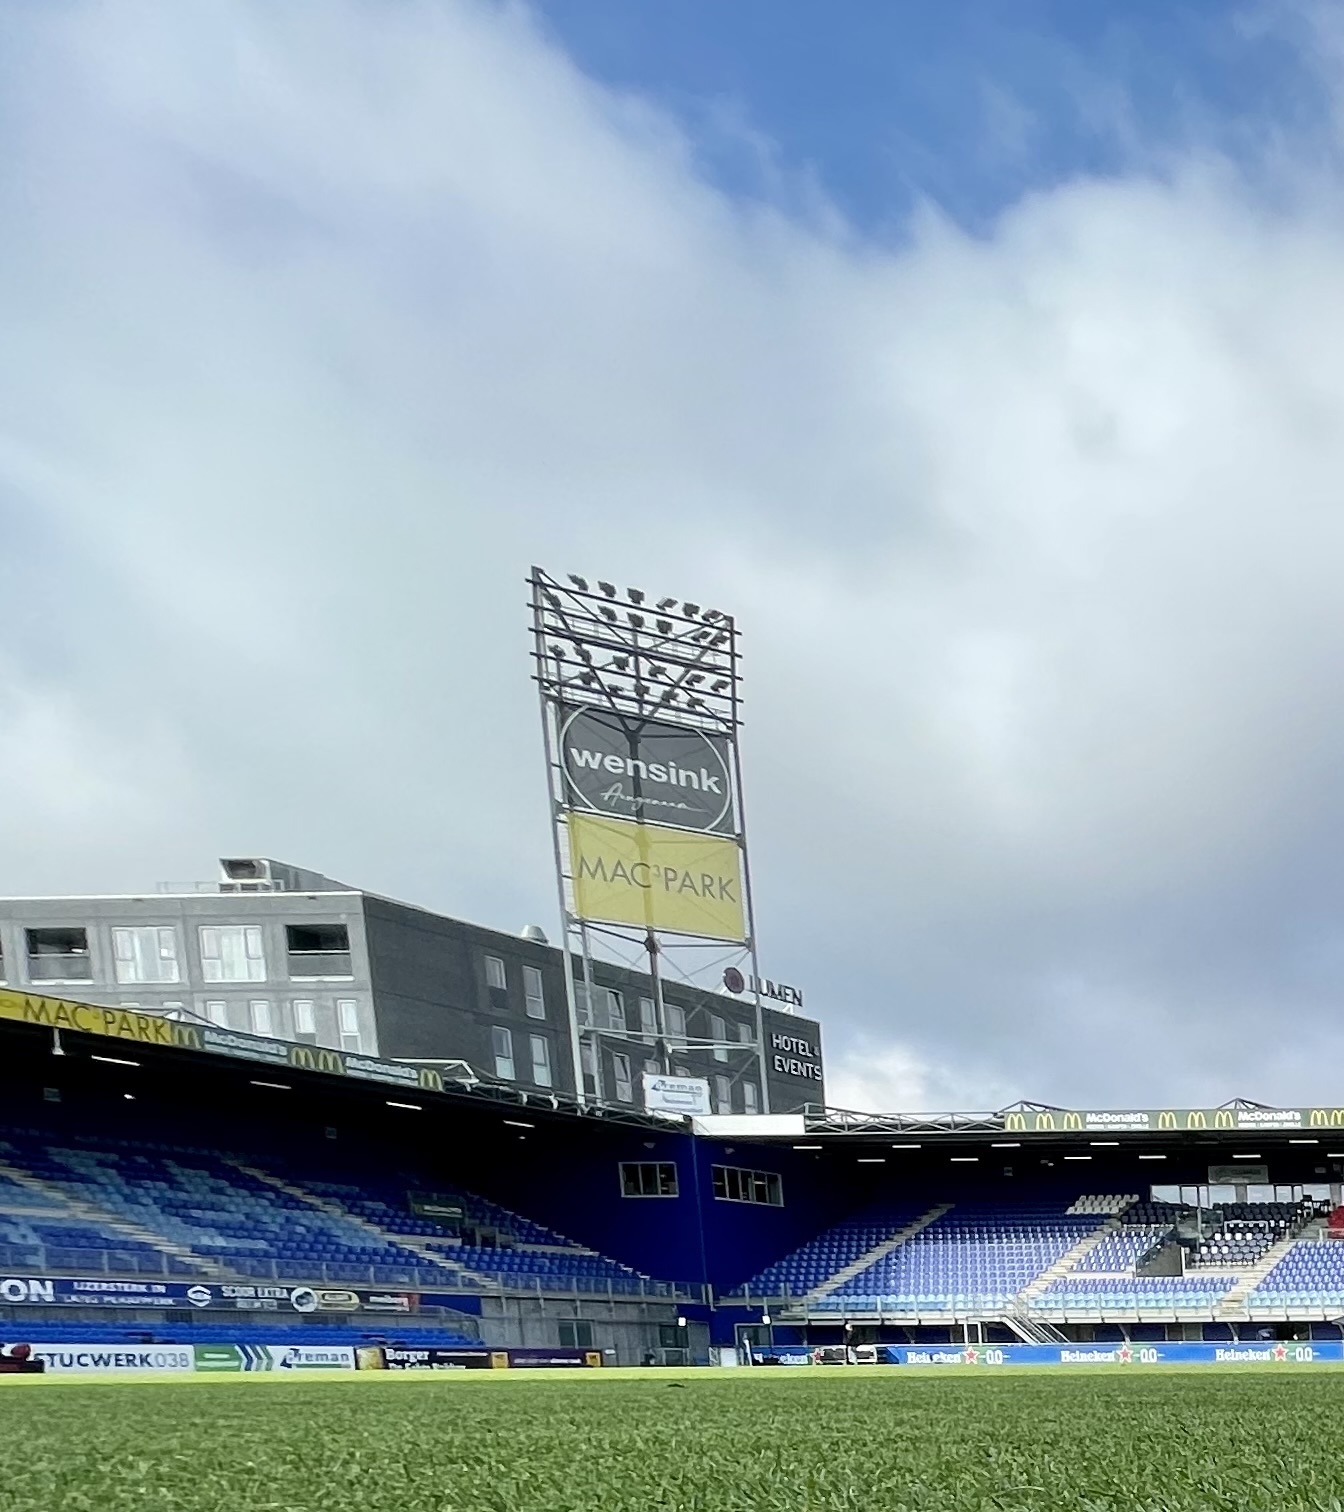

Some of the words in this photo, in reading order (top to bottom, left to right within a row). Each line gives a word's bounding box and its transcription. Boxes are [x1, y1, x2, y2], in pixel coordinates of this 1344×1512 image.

[570, 747, 722, 795] wensink
[771, 1033, 813, 1058] HOTEL
[774, 1055, 823, 1081] EVENTS
[1086, 1112, 1149, 1123] McDonald's
[1237, 1110, 1301, 1121] McDonald's
[1215, 1348, 1271, 1361] Heineken
